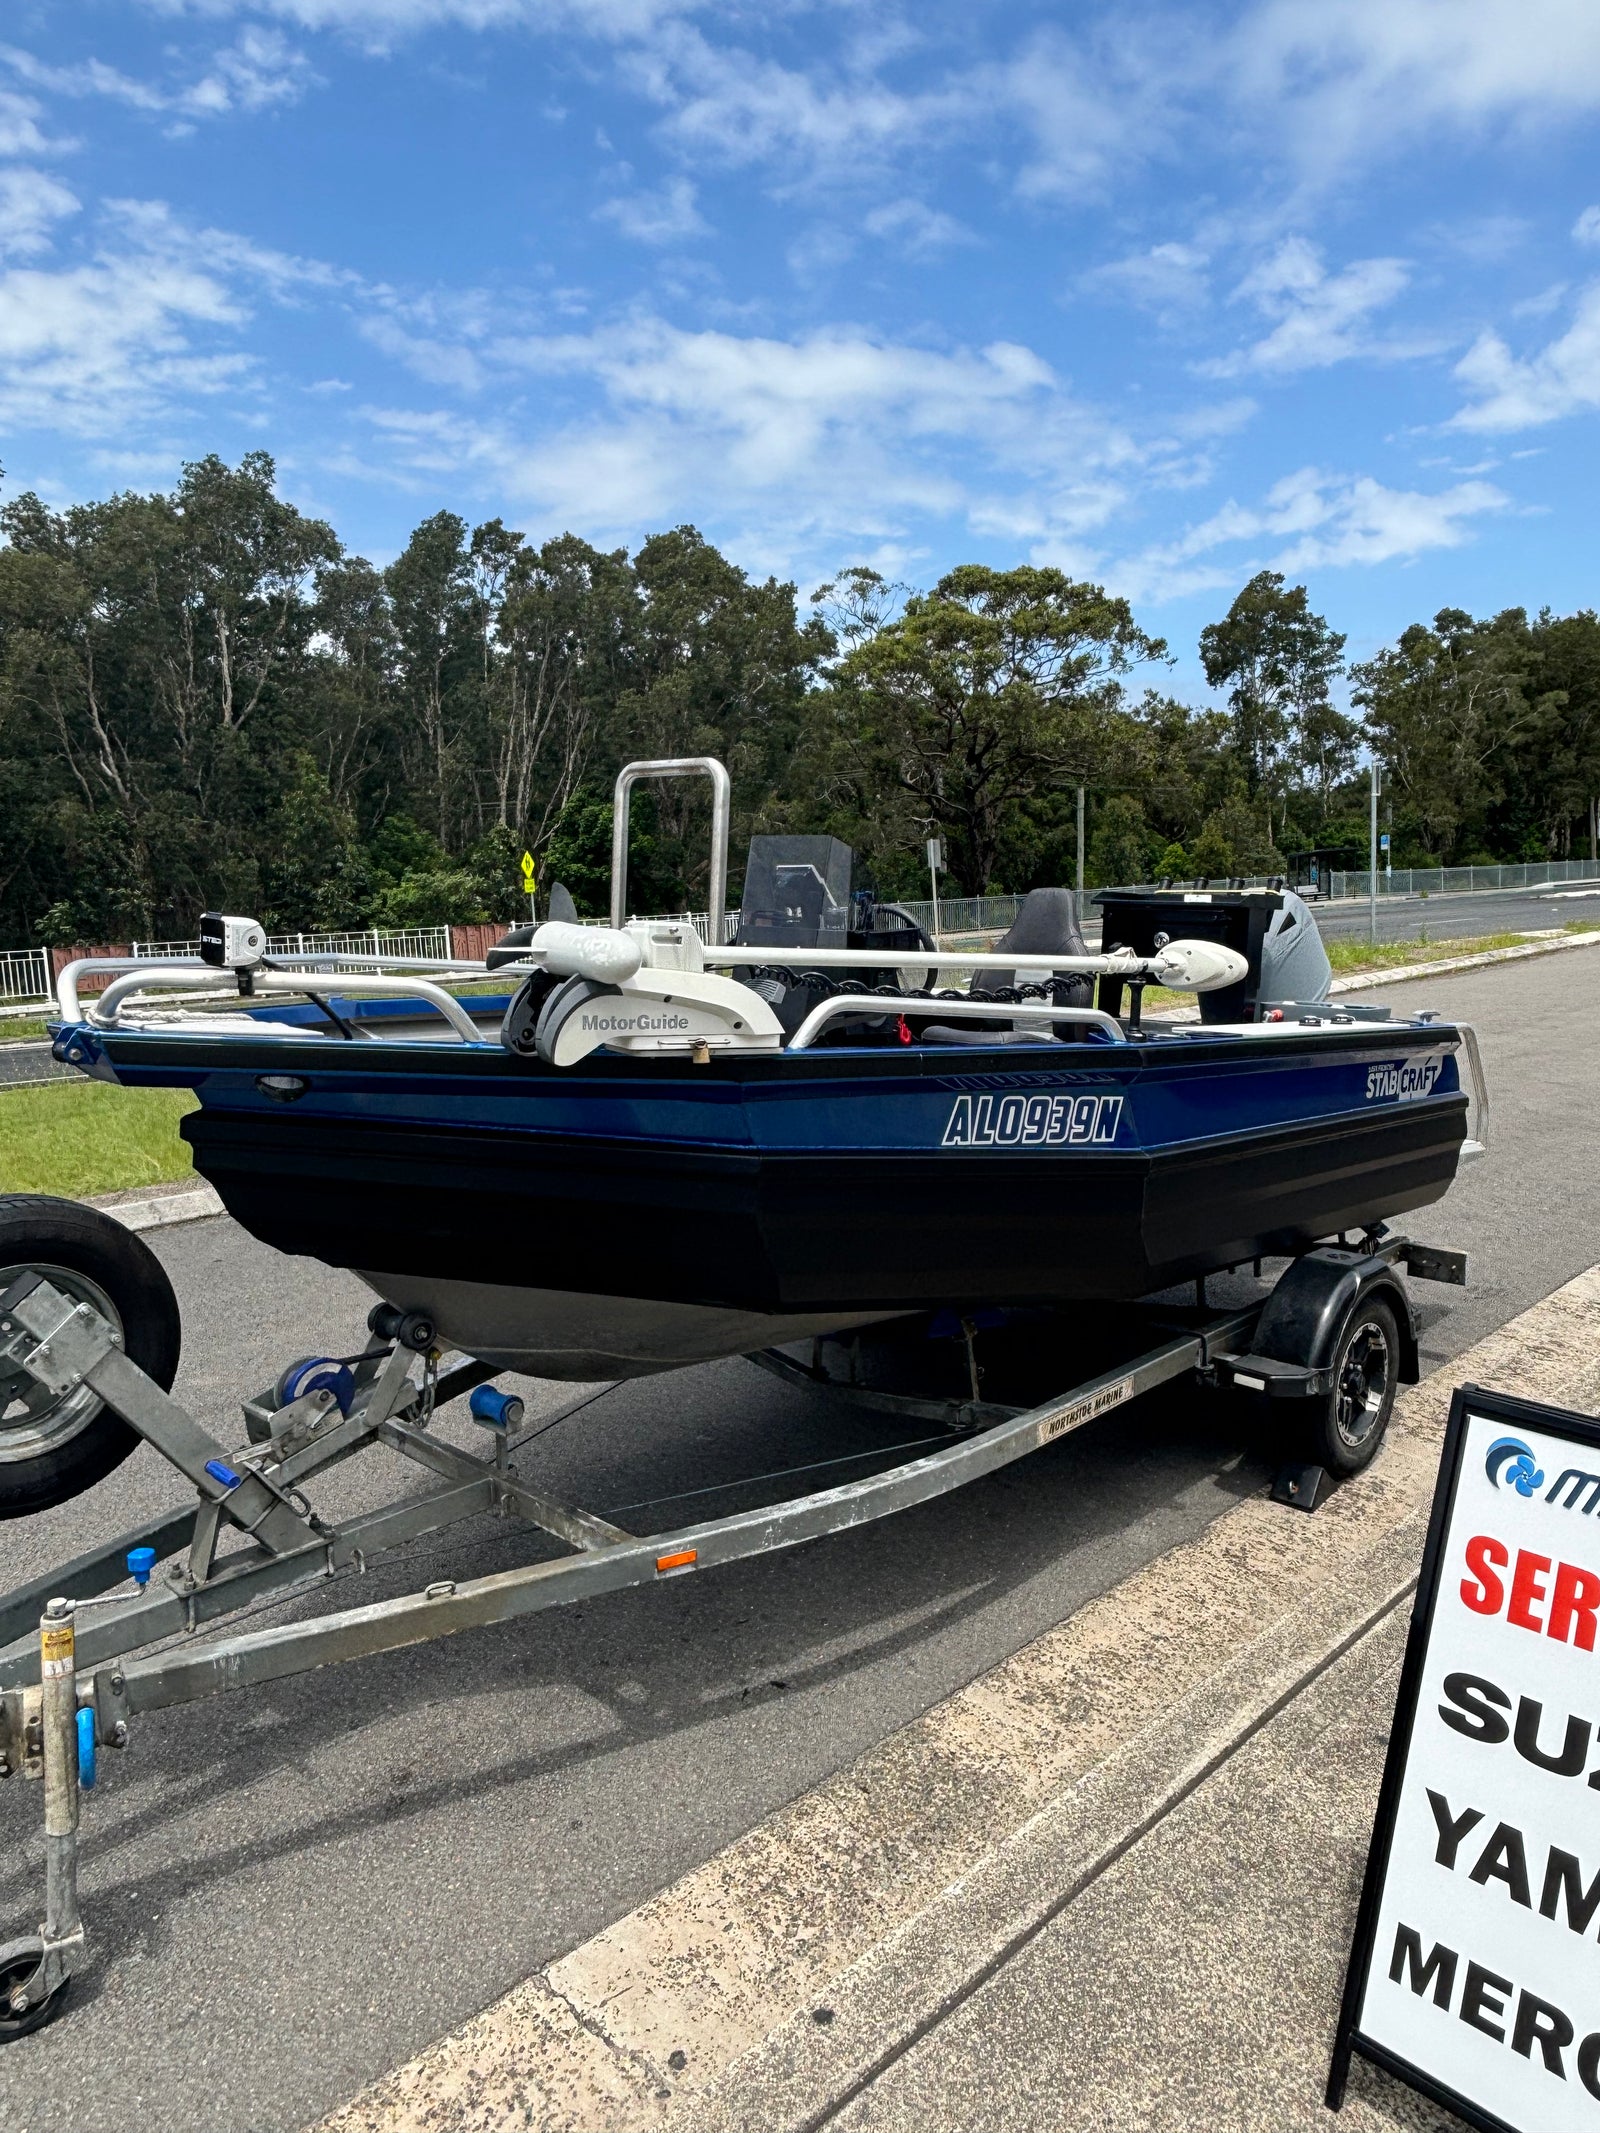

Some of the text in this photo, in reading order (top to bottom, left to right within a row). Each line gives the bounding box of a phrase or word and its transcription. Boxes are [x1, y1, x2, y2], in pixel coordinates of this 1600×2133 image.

[582, 1013, 689, 1030] MotorGuide
[1366, 1066, 1438, 1099] STABICRAFT
[1049, 1386, 1124, 1436] NORTHSIDE MARINE
[1544, 1468, 1600, 1519] M
[1460, 1535, 1600, 1653] SER
[1438, 1672, 1600, 1791] SU
